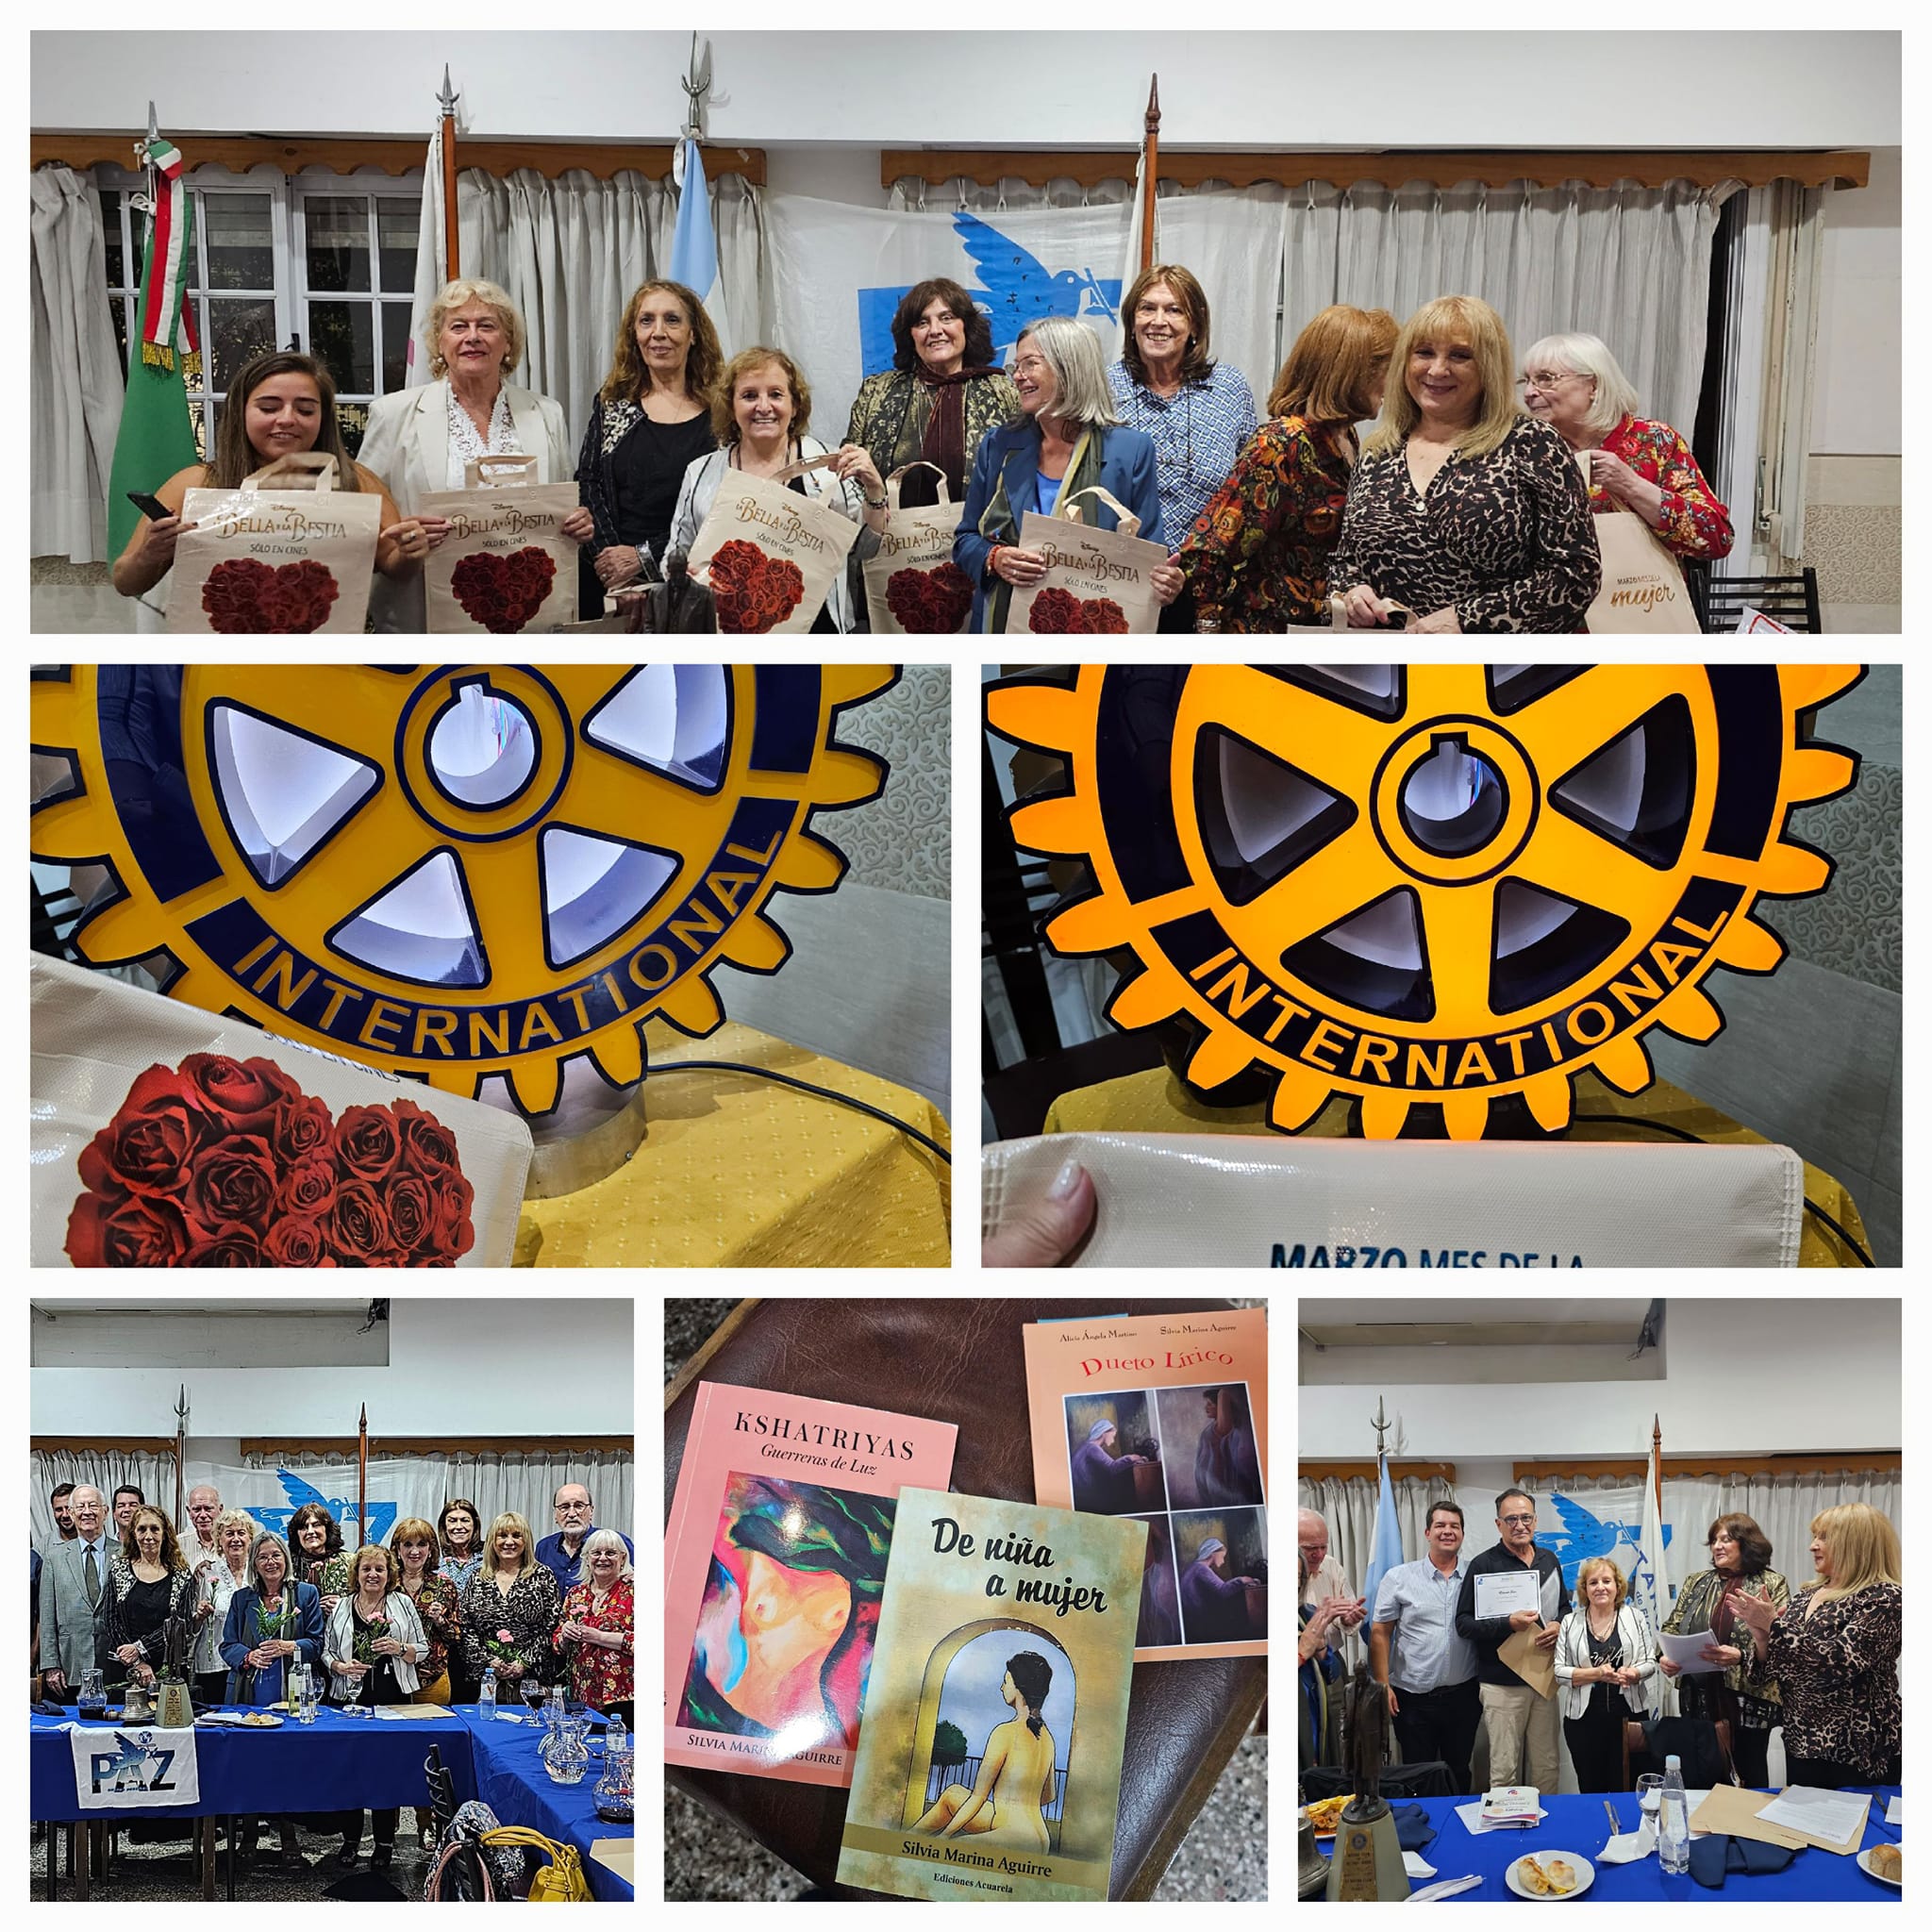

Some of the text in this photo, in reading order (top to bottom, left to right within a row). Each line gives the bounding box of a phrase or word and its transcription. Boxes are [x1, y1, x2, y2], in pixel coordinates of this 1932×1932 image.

[215, 512, 275, 539] BELLA
[285, 513, 346, 542] BESTIA
[452, 513, 499, 540] BELLA
[506, 510, 555, 535] BESTIA
[735, 497, 779, 529] BELLA
[782, 518, 824, 553] BESTIA
[272, 544, 283, 554] EN
[285, 545, 308, 556] CINES
[882, 532, 921, 557] BELLA
[924, 527, 957, 551] BES
[1041, 541, 1084, 569] BELLA
[1091, 555, 1140, 583] BESTIA
[1610, 584, 1675, 612] mujer
[232, 829, 784, 1058] INTERNATIONAL
[1190, 910, 1730, 1089] INTERNATIONAL
[1271, 1243, 1407, 1268] MARZO
[1159, 1324, 1237, 1336] Silvia Marina Aguirre
[1079, 1346, 1234, 1377] Dueto Lírico
[734, 1411, 914, 1461] KSHATRIYAS
[760, 1443, 878, 1475] Guerreras de Luz
[931, 1517, 1056, 1568] De niña
[985, 1574, 1108, 1617] a mujer
[687, 1734, 725, 1751] SILVIA
[902, 1840, 1053, 1877] Silvia Marina Aguirre
[934, 1873, 1014, 1893] Ediciones Acuarela
